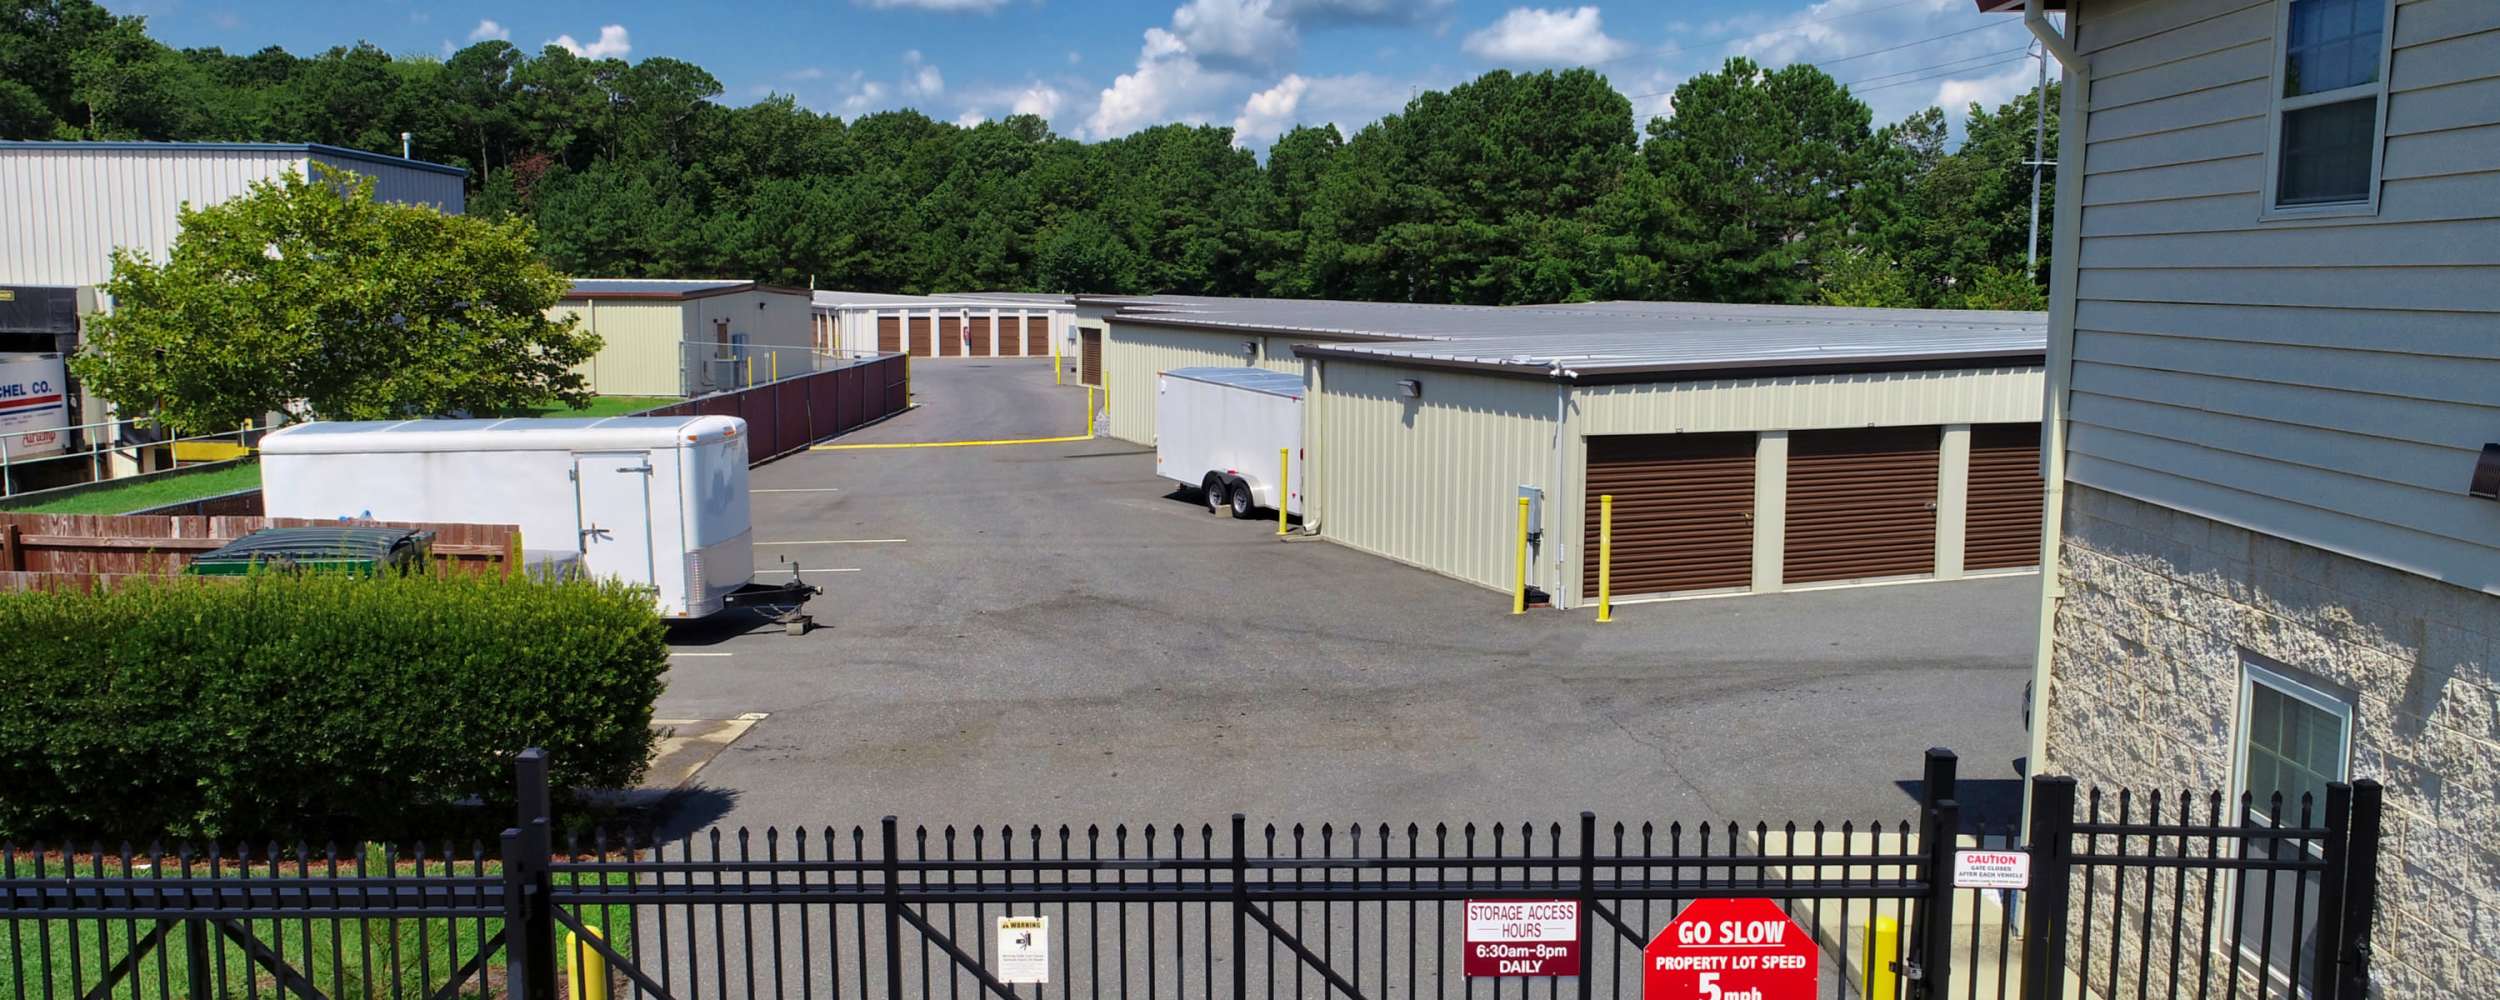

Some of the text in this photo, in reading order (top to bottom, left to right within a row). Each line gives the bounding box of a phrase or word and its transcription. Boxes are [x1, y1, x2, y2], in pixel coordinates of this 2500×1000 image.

[0, 381, 52, 398] HEL CO.
[1967, 855, 2017, 865] CAUTION
[1470, 905, 1574, 920] STORAGE ACCESS
[1502, 923, 1542, 938] HOURS
[1678, 920, 1786, 944] GO SLOW
[1476, 944, 1567, 960] 6:30am-8pm
[1499, 960, 1543, 973] DAILY
[1656, 955, 1806, 970] PROPERTY LOT SPEED
[1699, 972, 1762, 1000] 5 mph
